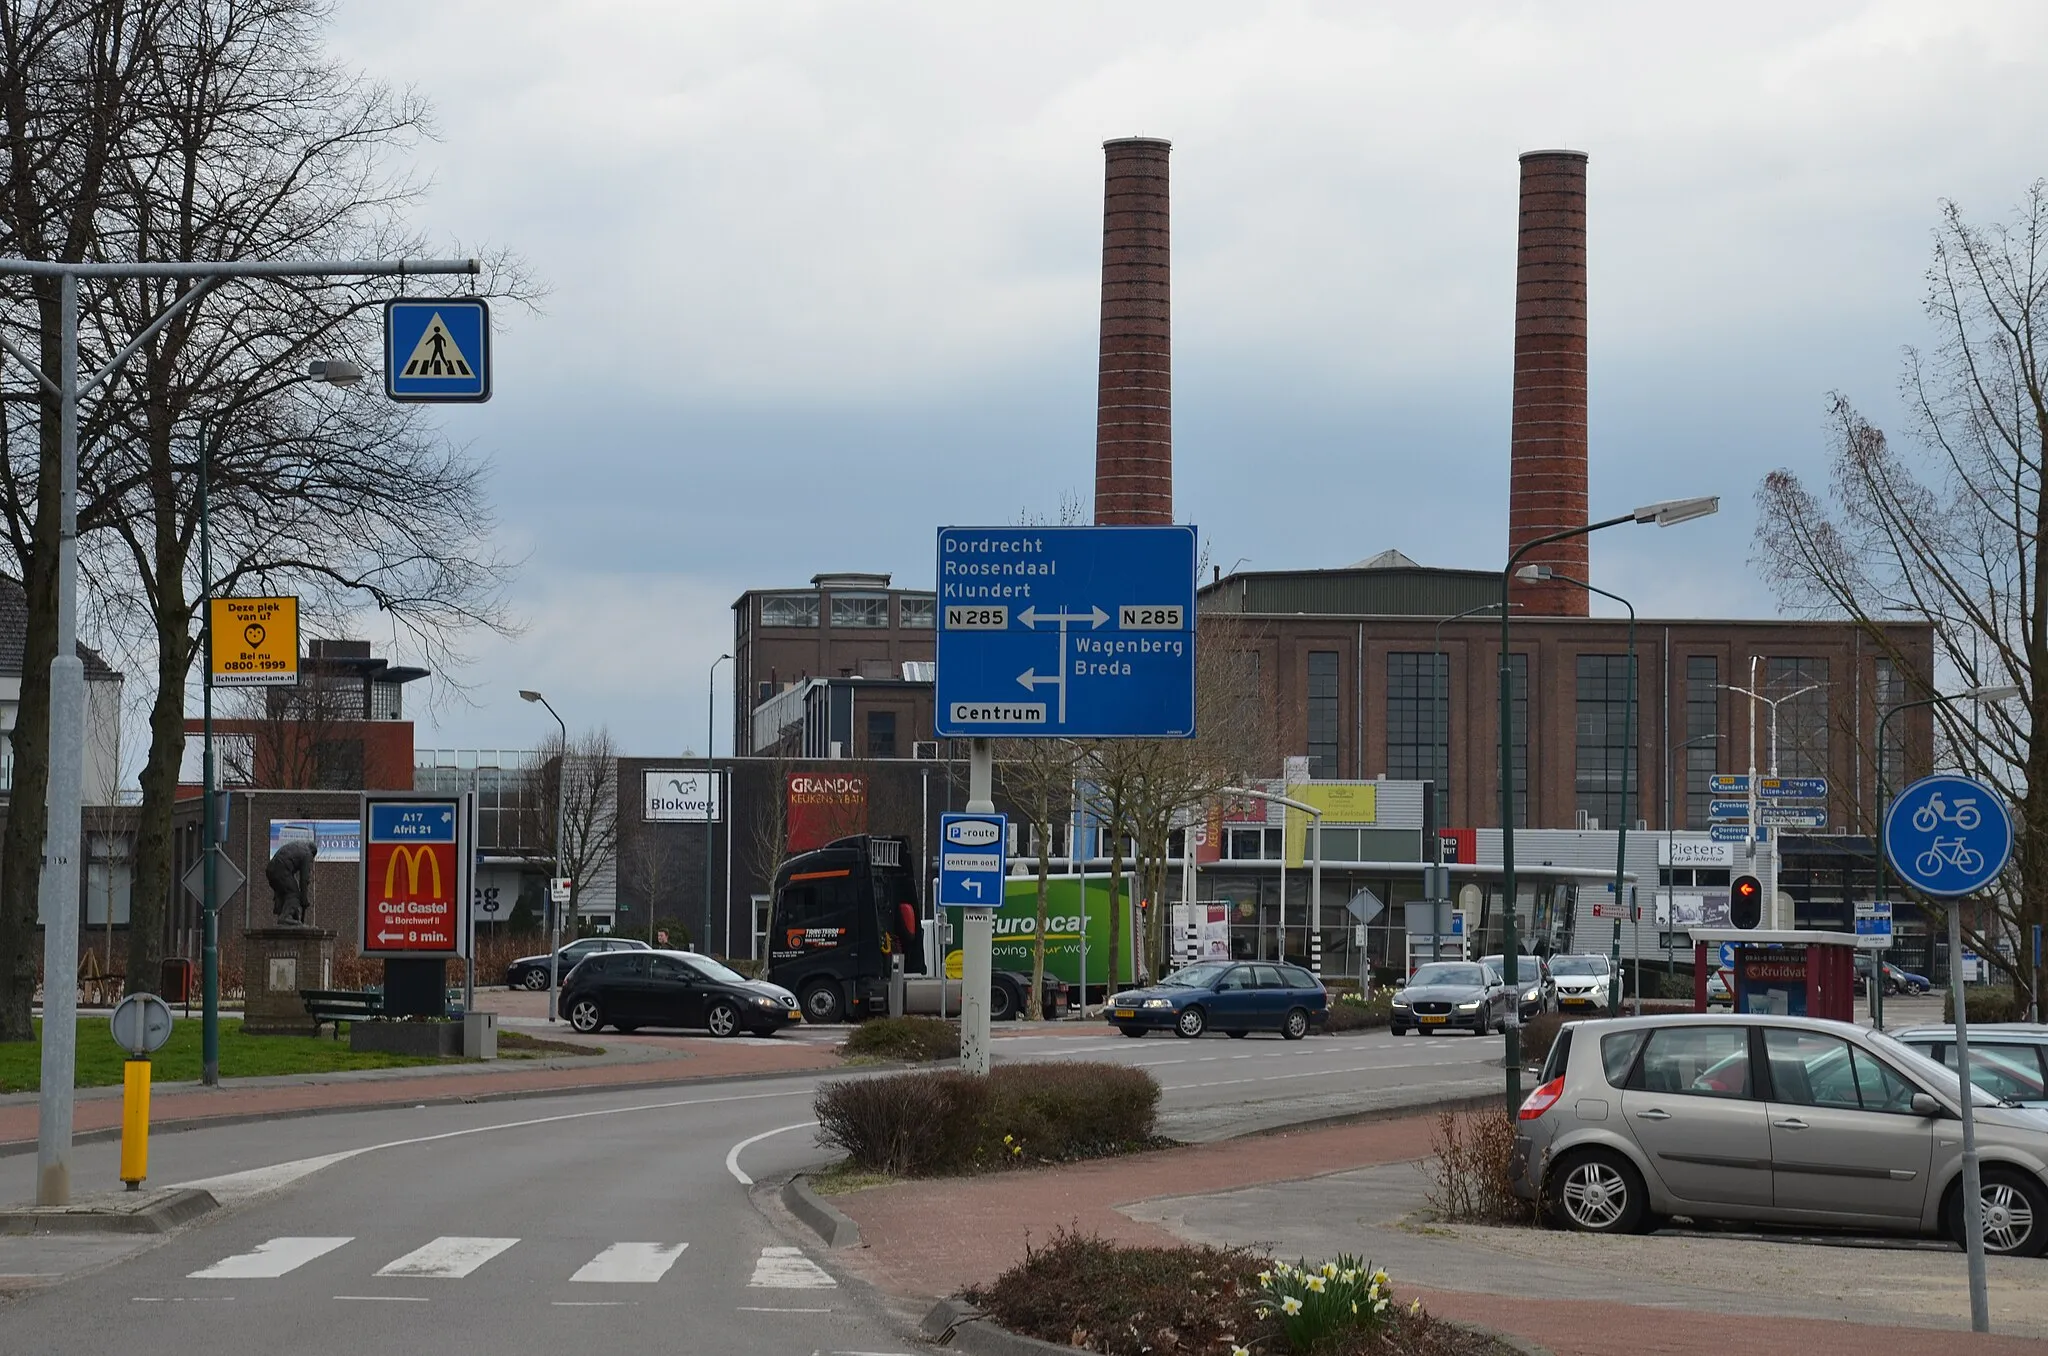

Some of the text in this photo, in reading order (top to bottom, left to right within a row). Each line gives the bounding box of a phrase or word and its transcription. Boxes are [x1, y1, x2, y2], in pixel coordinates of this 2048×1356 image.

[945, 538, 1043, 553] Dordrecht
[945, 560, 1056, 576] Roosendaal
[944, 583, 1031, 598] Klundert
[228, 603, 280, 613] Deze plek
[260, 612, 271, 621] u?
[1075, 638, 1183, 657] Wagenberg
[240, 652, 255, 660] Bel
[1075, 661, 1131, 676] Breda
[215, 674, 296, 682] lichtmastreclame.nl
[956, 705, 1041, 721] Centrum
[791, 777, 862, 794] GRANDO
[403, 813, 423, 822] A17
[393, 825, 431, 834] Afrit 21
[1670, 843, 1724, 855] Pieters
[378, 902, 447, 913] Oud Gastel
[409, 930, 447, 942] 8 min.
[992, 945, 1027, 958] oving
[1761, 965, 1807, 977] Kruidvat
